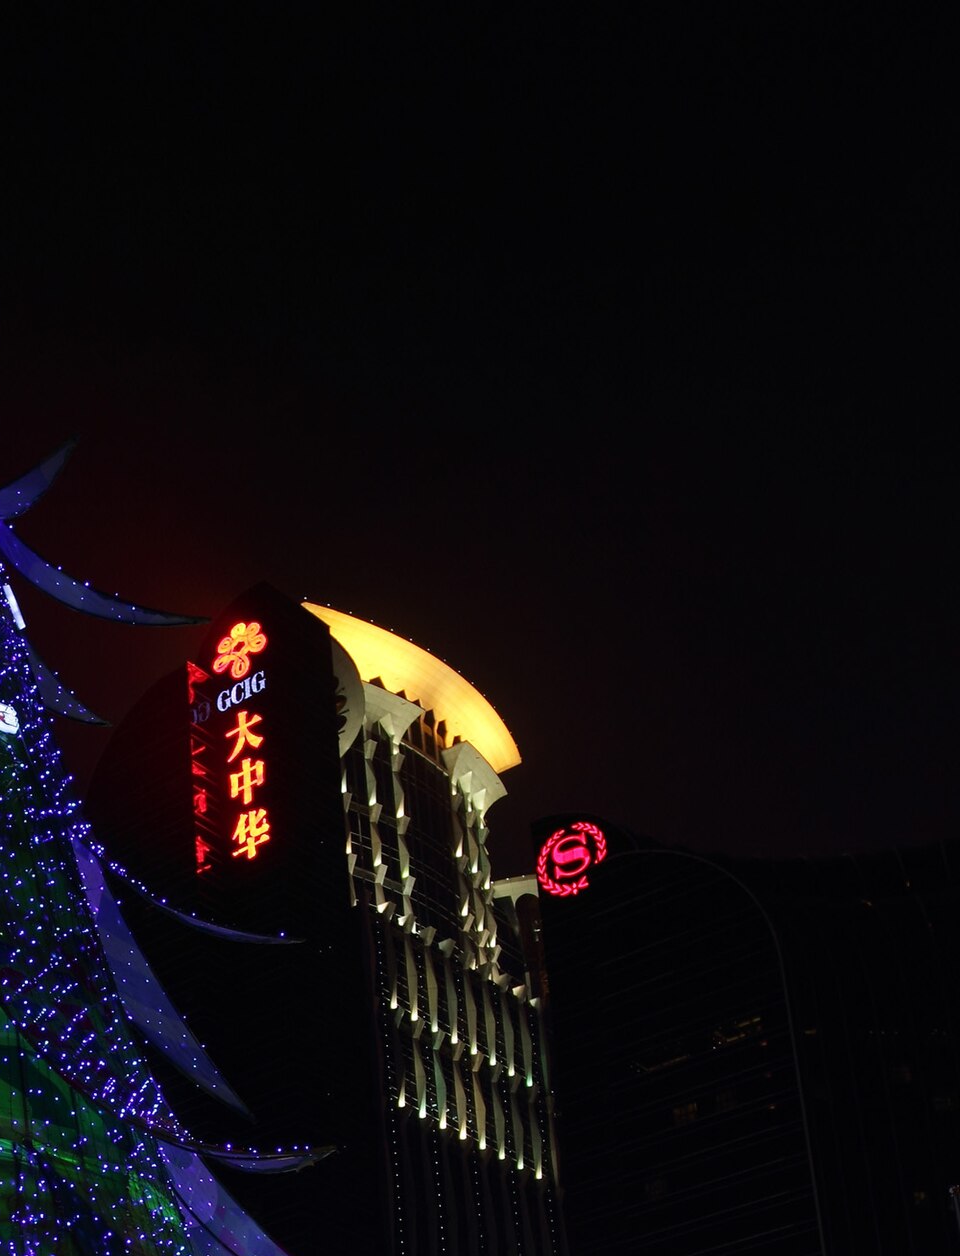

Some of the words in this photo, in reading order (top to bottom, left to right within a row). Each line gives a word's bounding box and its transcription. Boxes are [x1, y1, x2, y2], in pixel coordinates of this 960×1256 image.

[216, 670, 267, 712] GCIG
[225, 711, 271, 859] 大中华
